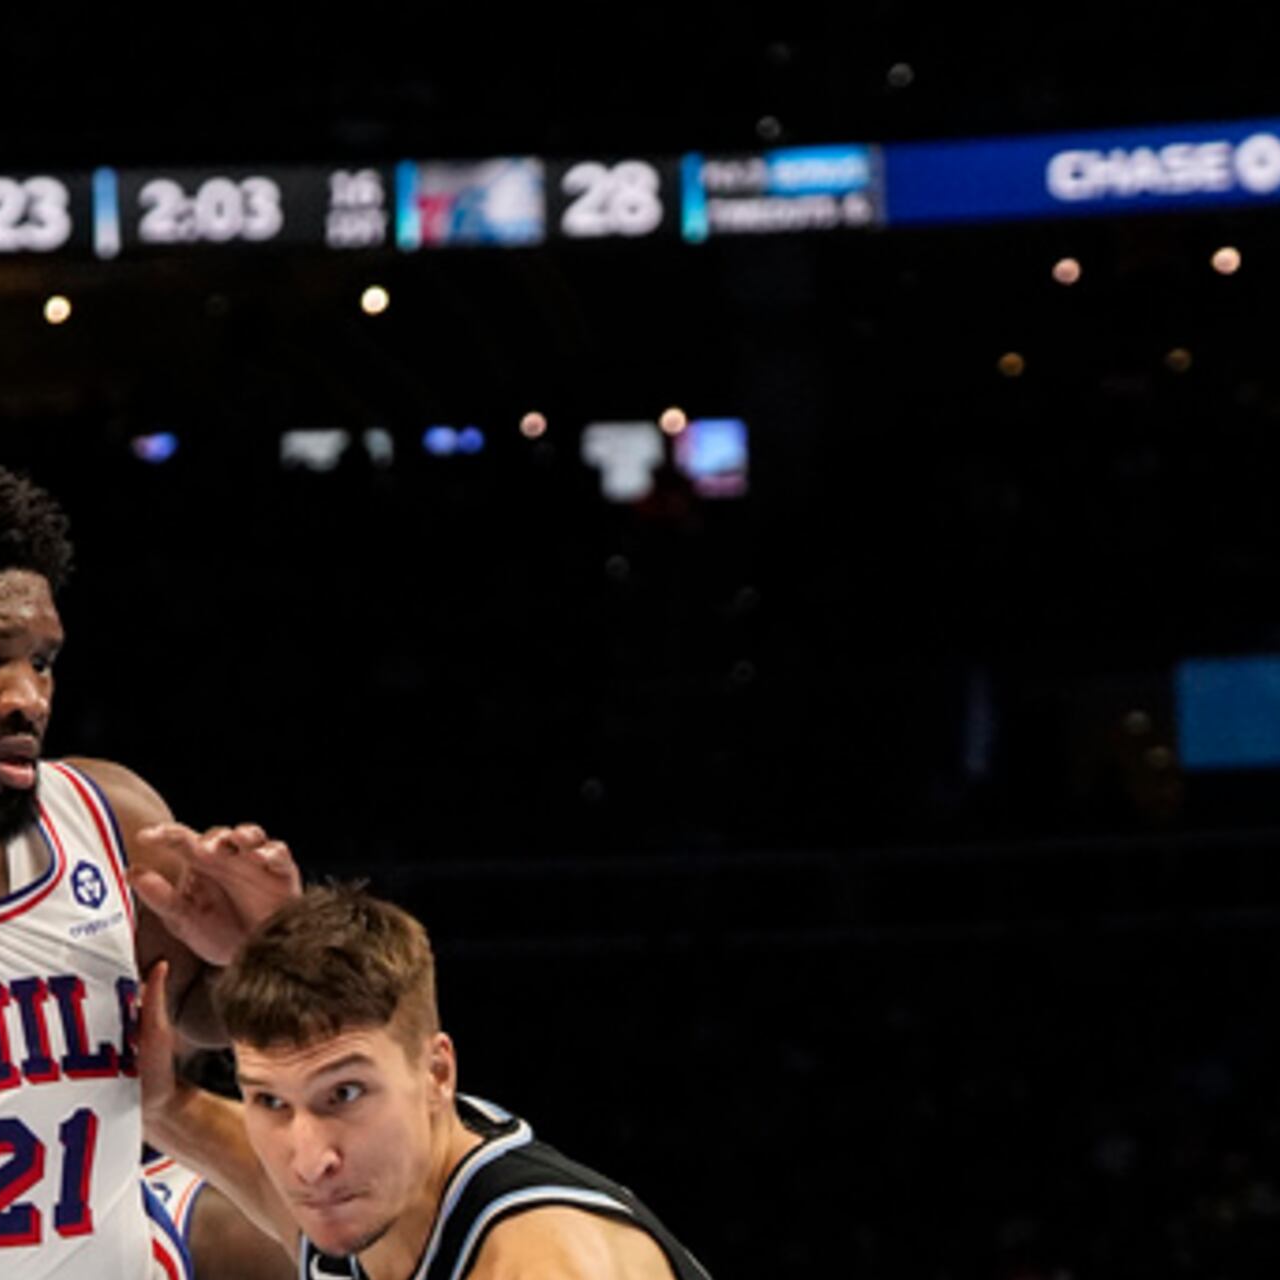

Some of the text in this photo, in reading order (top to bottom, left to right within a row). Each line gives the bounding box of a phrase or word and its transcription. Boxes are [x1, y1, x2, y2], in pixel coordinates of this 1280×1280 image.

[562, 161, 663, 236] 28
[1046, 142, 1235, 199] CHASE
[139, 177, 283, 241] 2:03
